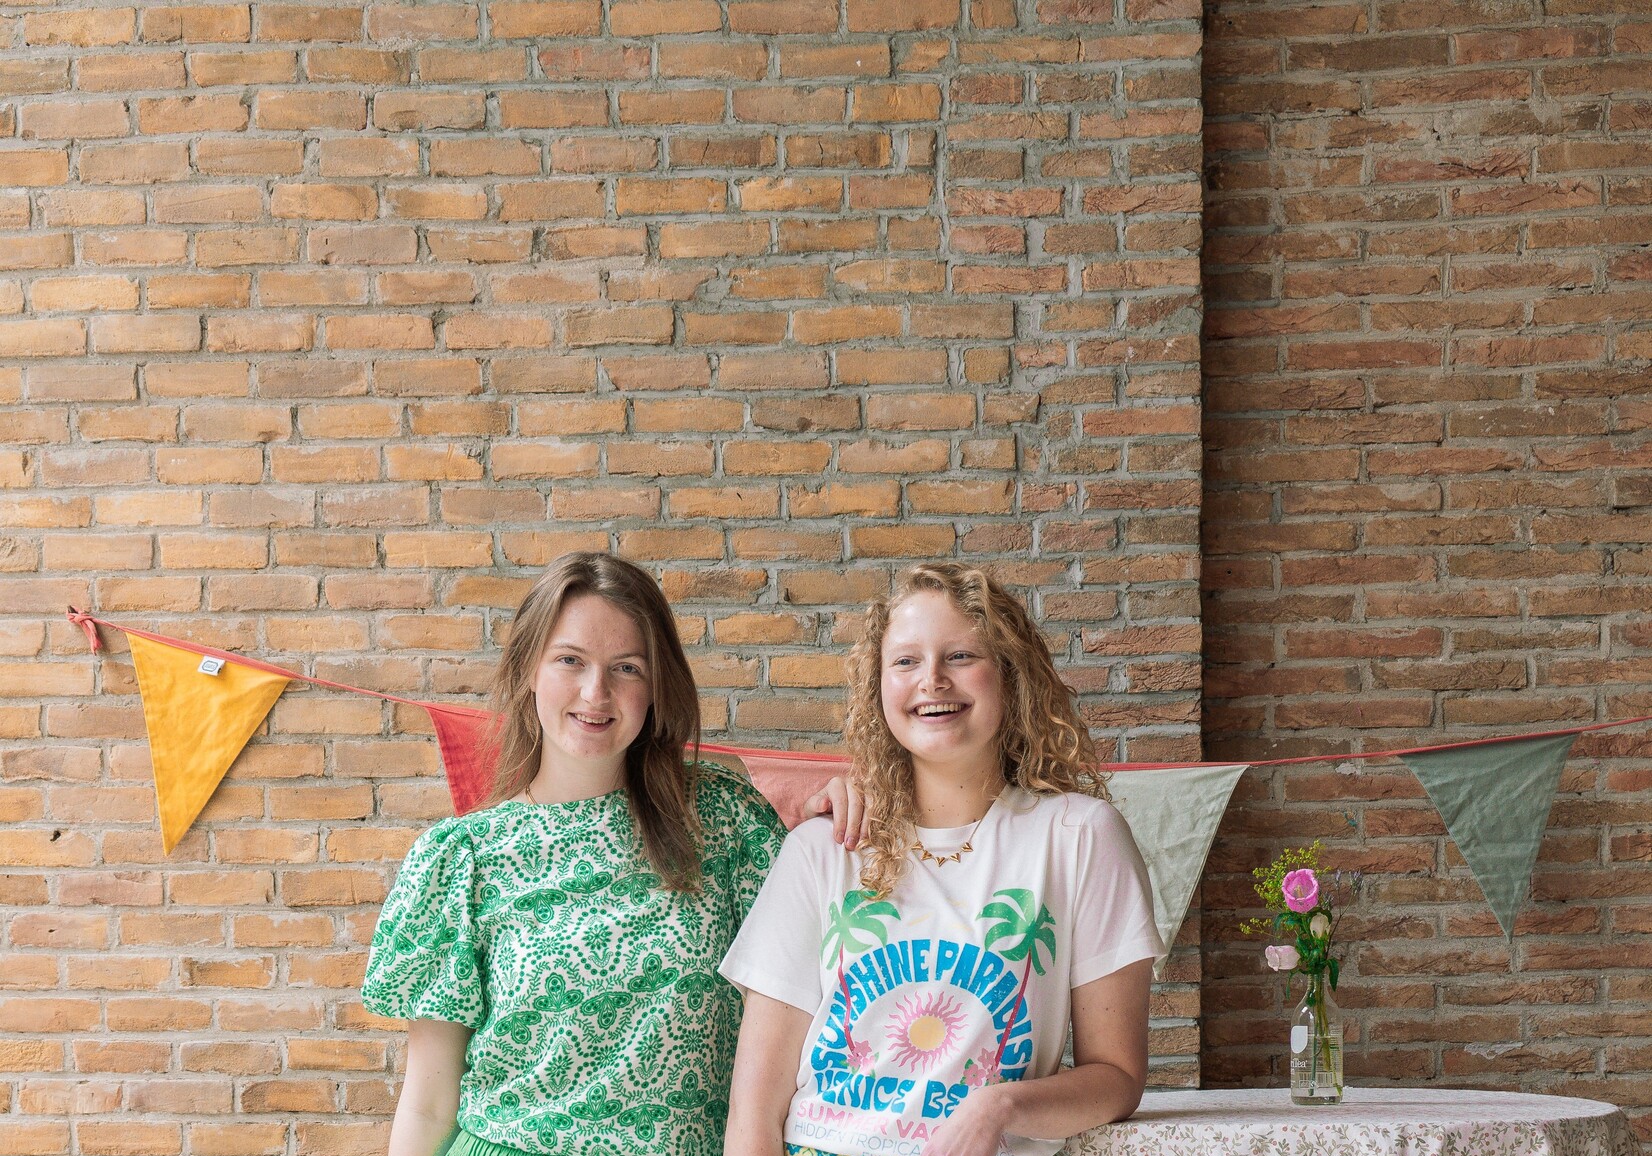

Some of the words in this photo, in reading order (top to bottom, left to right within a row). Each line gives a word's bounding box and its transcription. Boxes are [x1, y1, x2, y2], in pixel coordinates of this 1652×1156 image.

[811, 939, 930, 1070] SUNSHINE
[814, 1070, 916, 1114] VENICE
[849, 1132, 920, 1156] TROPICA
